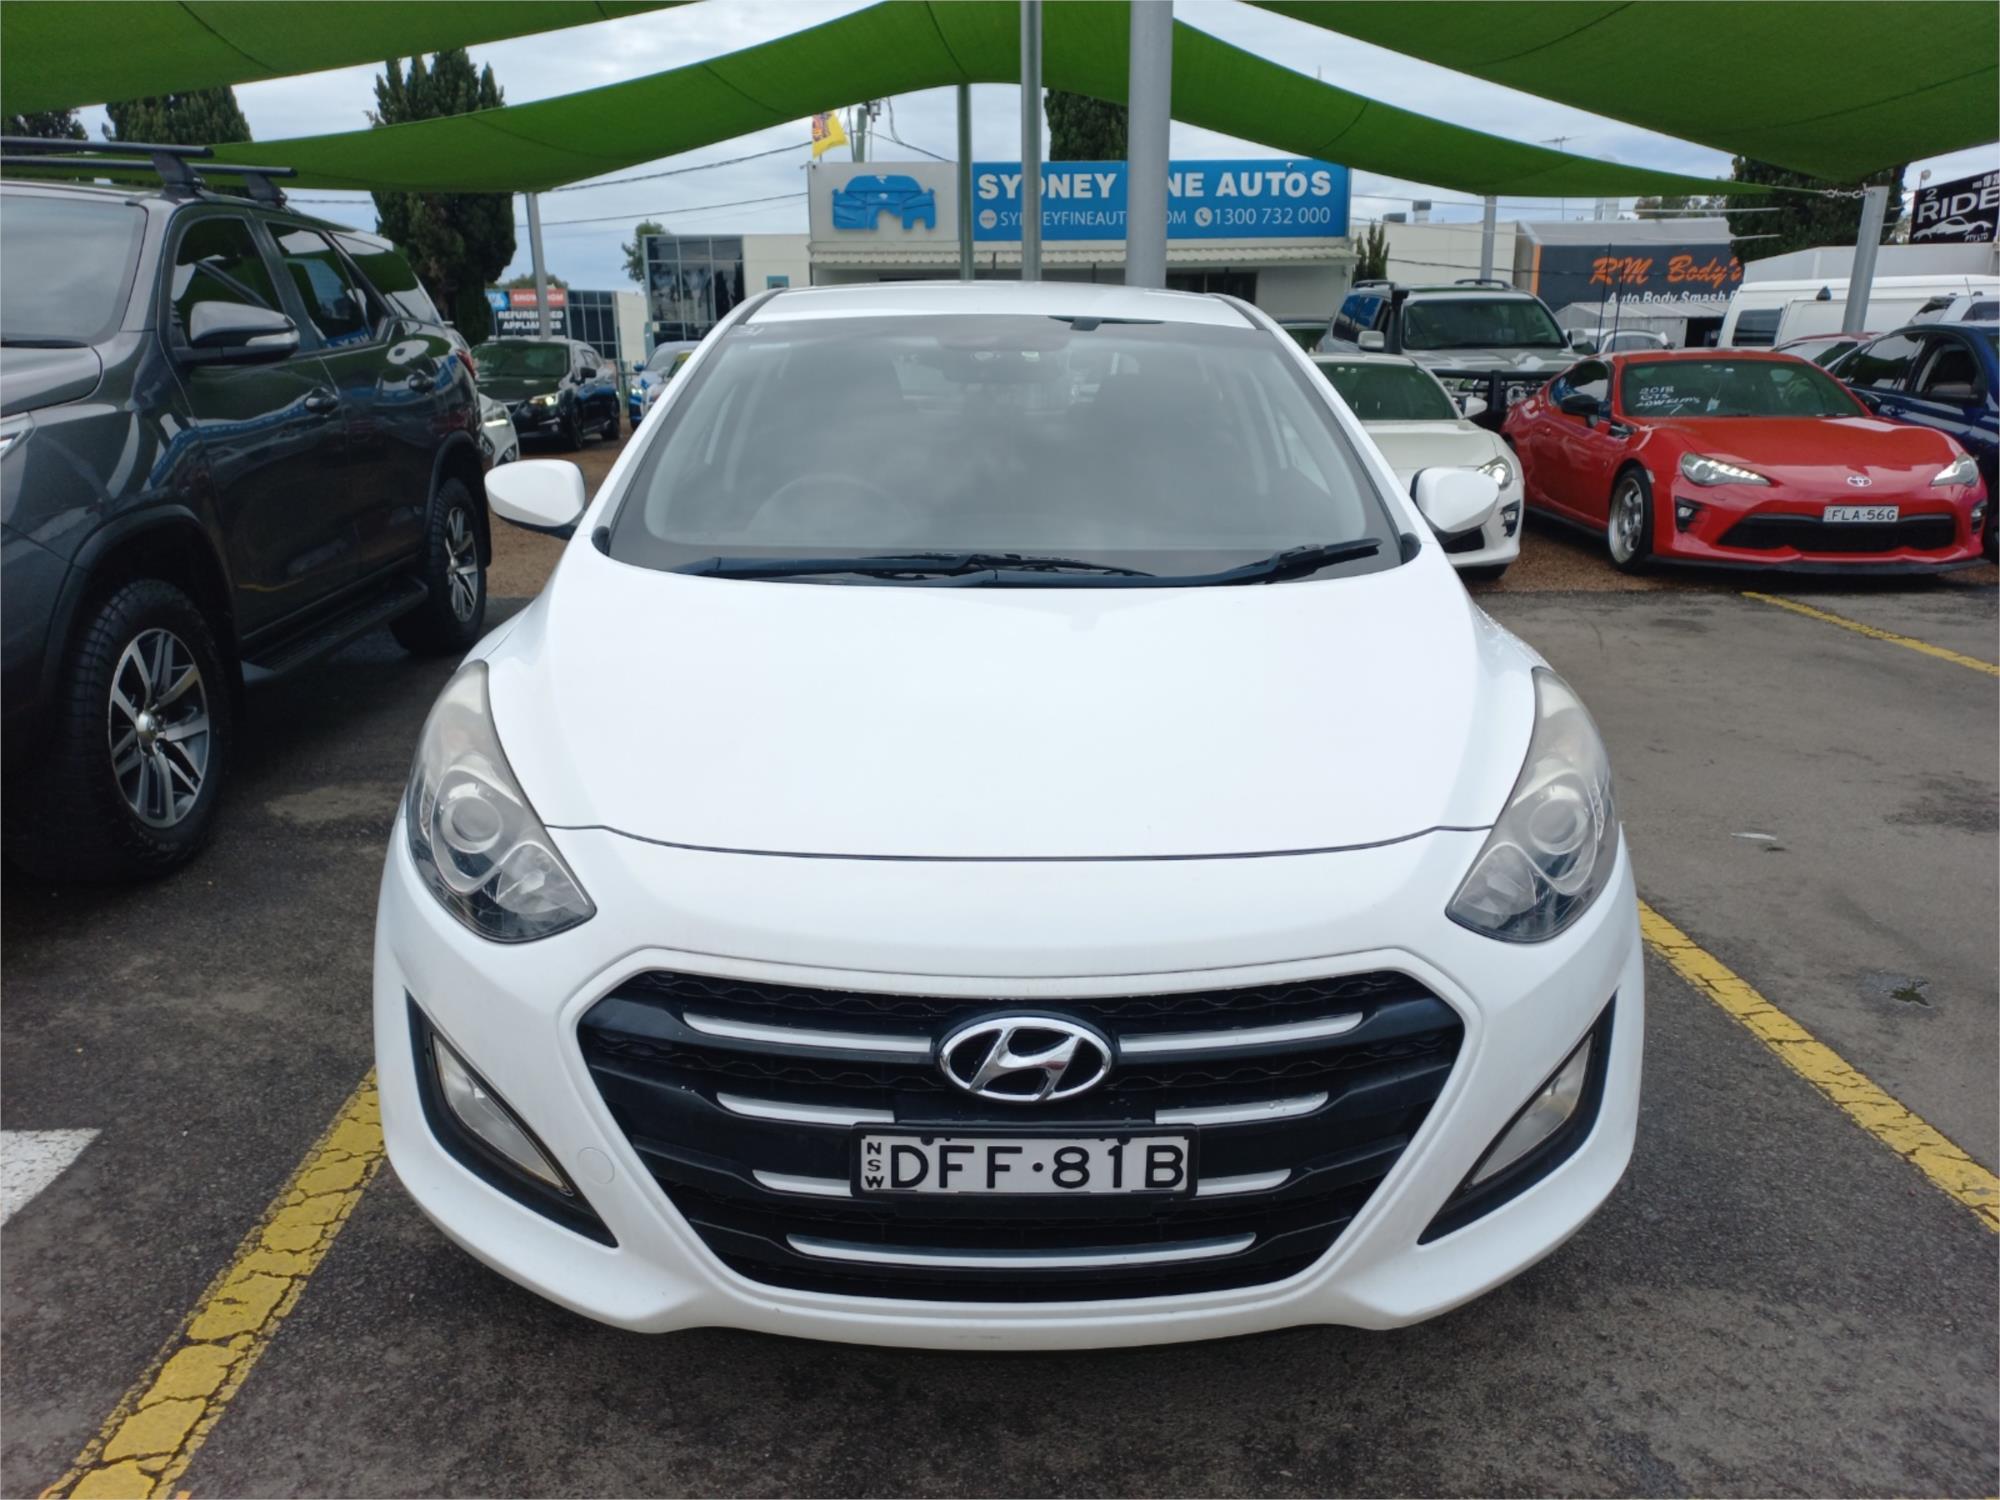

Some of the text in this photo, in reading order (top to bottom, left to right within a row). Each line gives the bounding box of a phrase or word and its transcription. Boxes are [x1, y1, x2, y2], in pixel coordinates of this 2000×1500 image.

[978, 173, 1117, 200] SYNEY
[1215, 170, 1332, 198] AUTOS
[1925, 187, 1938, 200] 2
[1215, 208, 1257, 225] 1300
[1262, 207, 1293, 224] 732
[1297, 207, 1331, 224] 000
[1917, 185, 1999, 224] RIDE
[1643, 290, 1678, 304] Body
[1680, 290, 1726, 303] Smash
[864, 1141, 885, 1189] NSW
